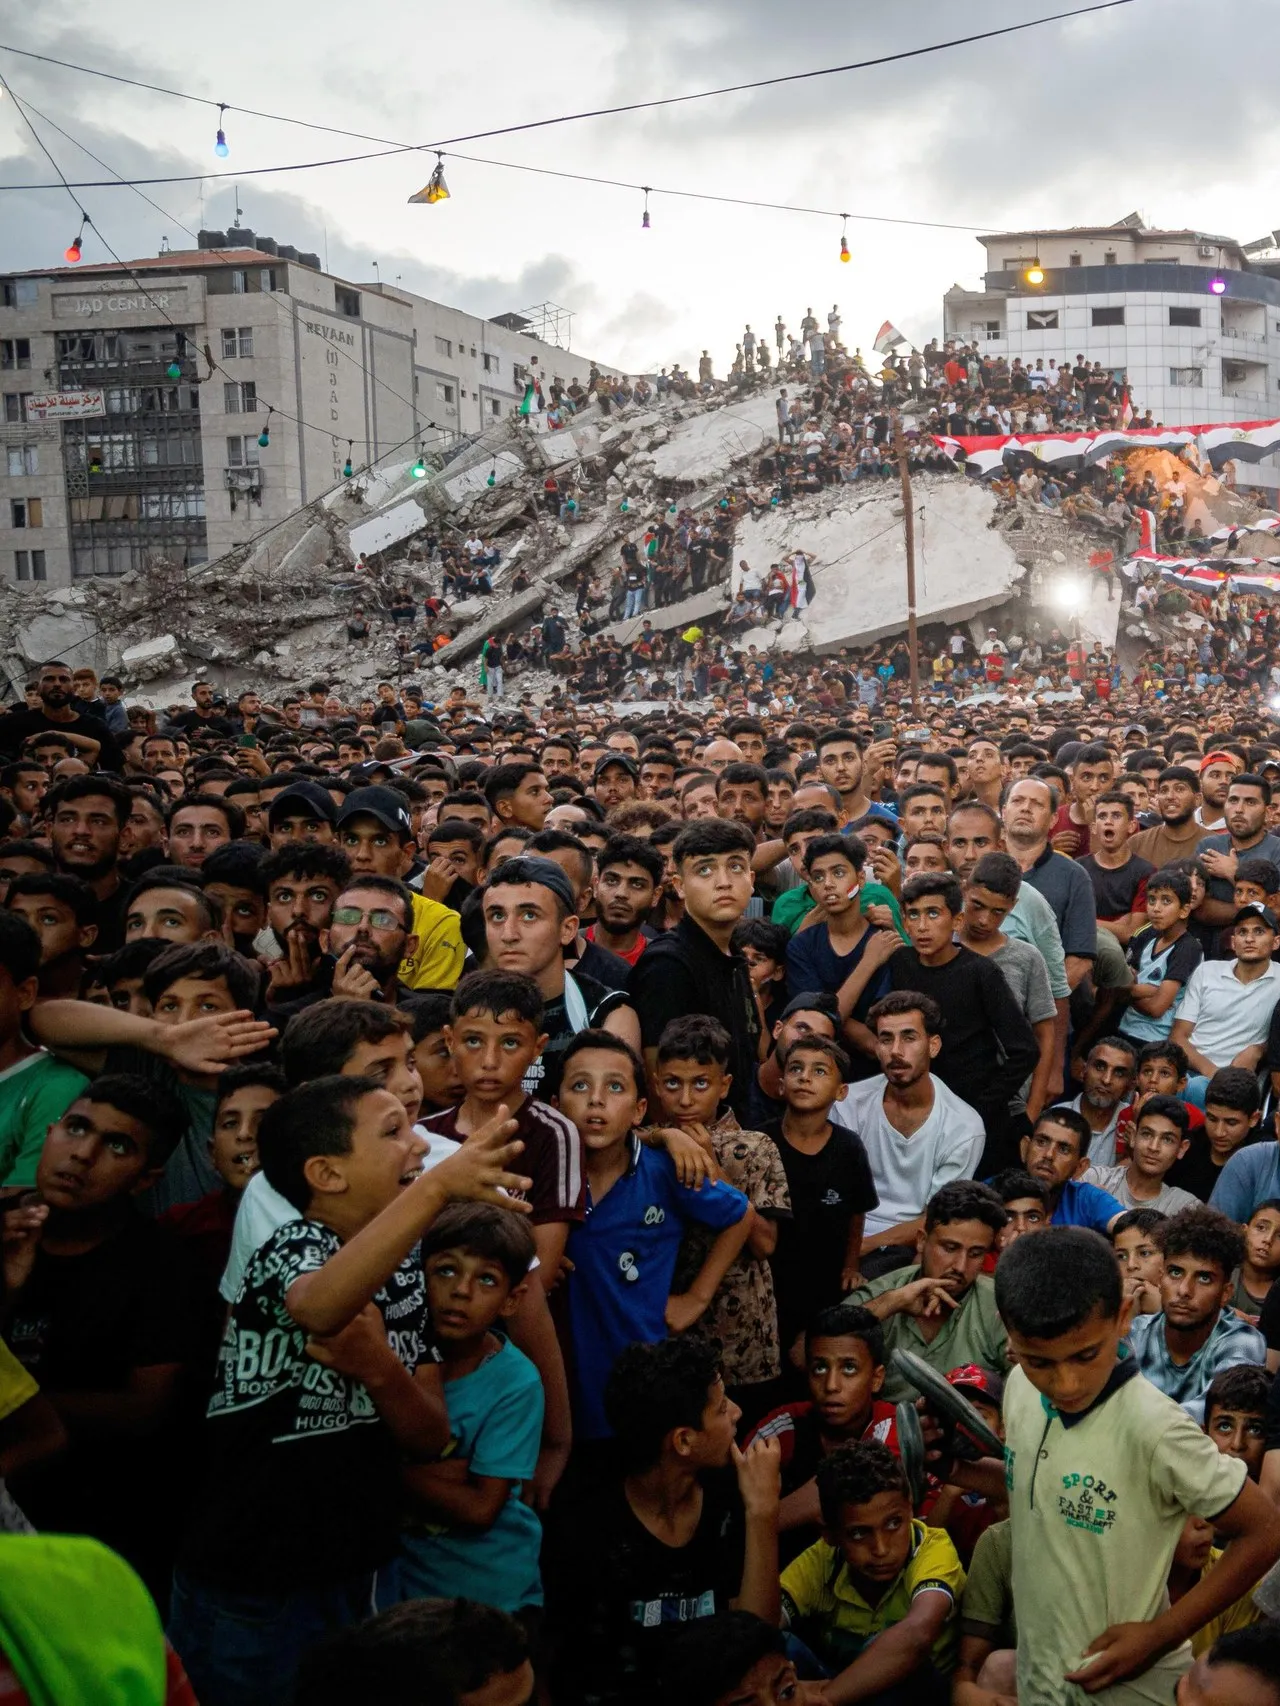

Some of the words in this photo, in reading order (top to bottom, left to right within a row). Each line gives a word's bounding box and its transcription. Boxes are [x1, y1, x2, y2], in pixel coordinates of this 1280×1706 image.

[75, 299, 103, 313] JAD
[107, 294, 170, 312] CENTER
[306, 321, 354, 346] REVAAN
[296, 1413, 348, 1430] HUGO
[1062, 1473, 1117, 1503] SPORT
[1080, 1489, 1093, 1505] &
[1059, 1495, 1116, 1521] FASTER
